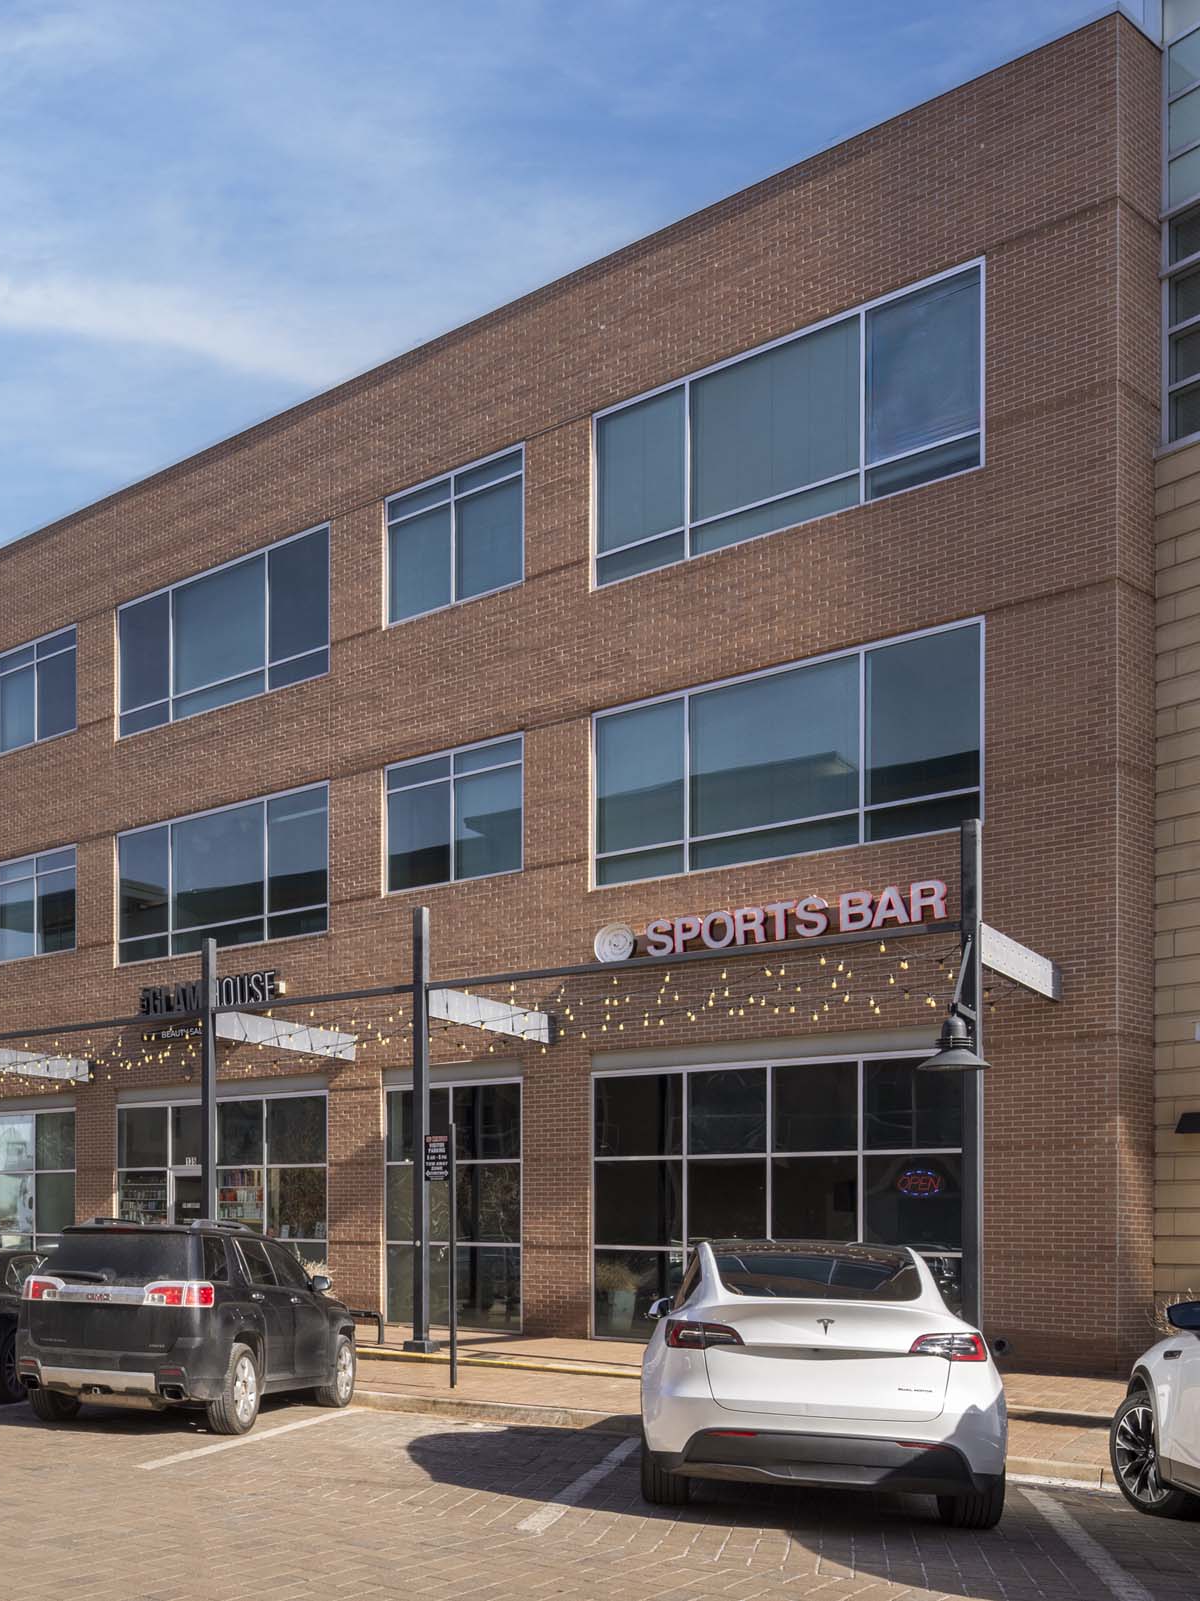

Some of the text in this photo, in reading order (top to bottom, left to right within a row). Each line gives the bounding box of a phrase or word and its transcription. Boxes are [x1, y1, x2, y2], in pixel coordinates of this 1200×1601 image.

[646, 879, 948, 957] SPORTS BAR
[161, 1027, 188, 1039] BEAUTY
[897, 1176, 941, 1192] OPEN
